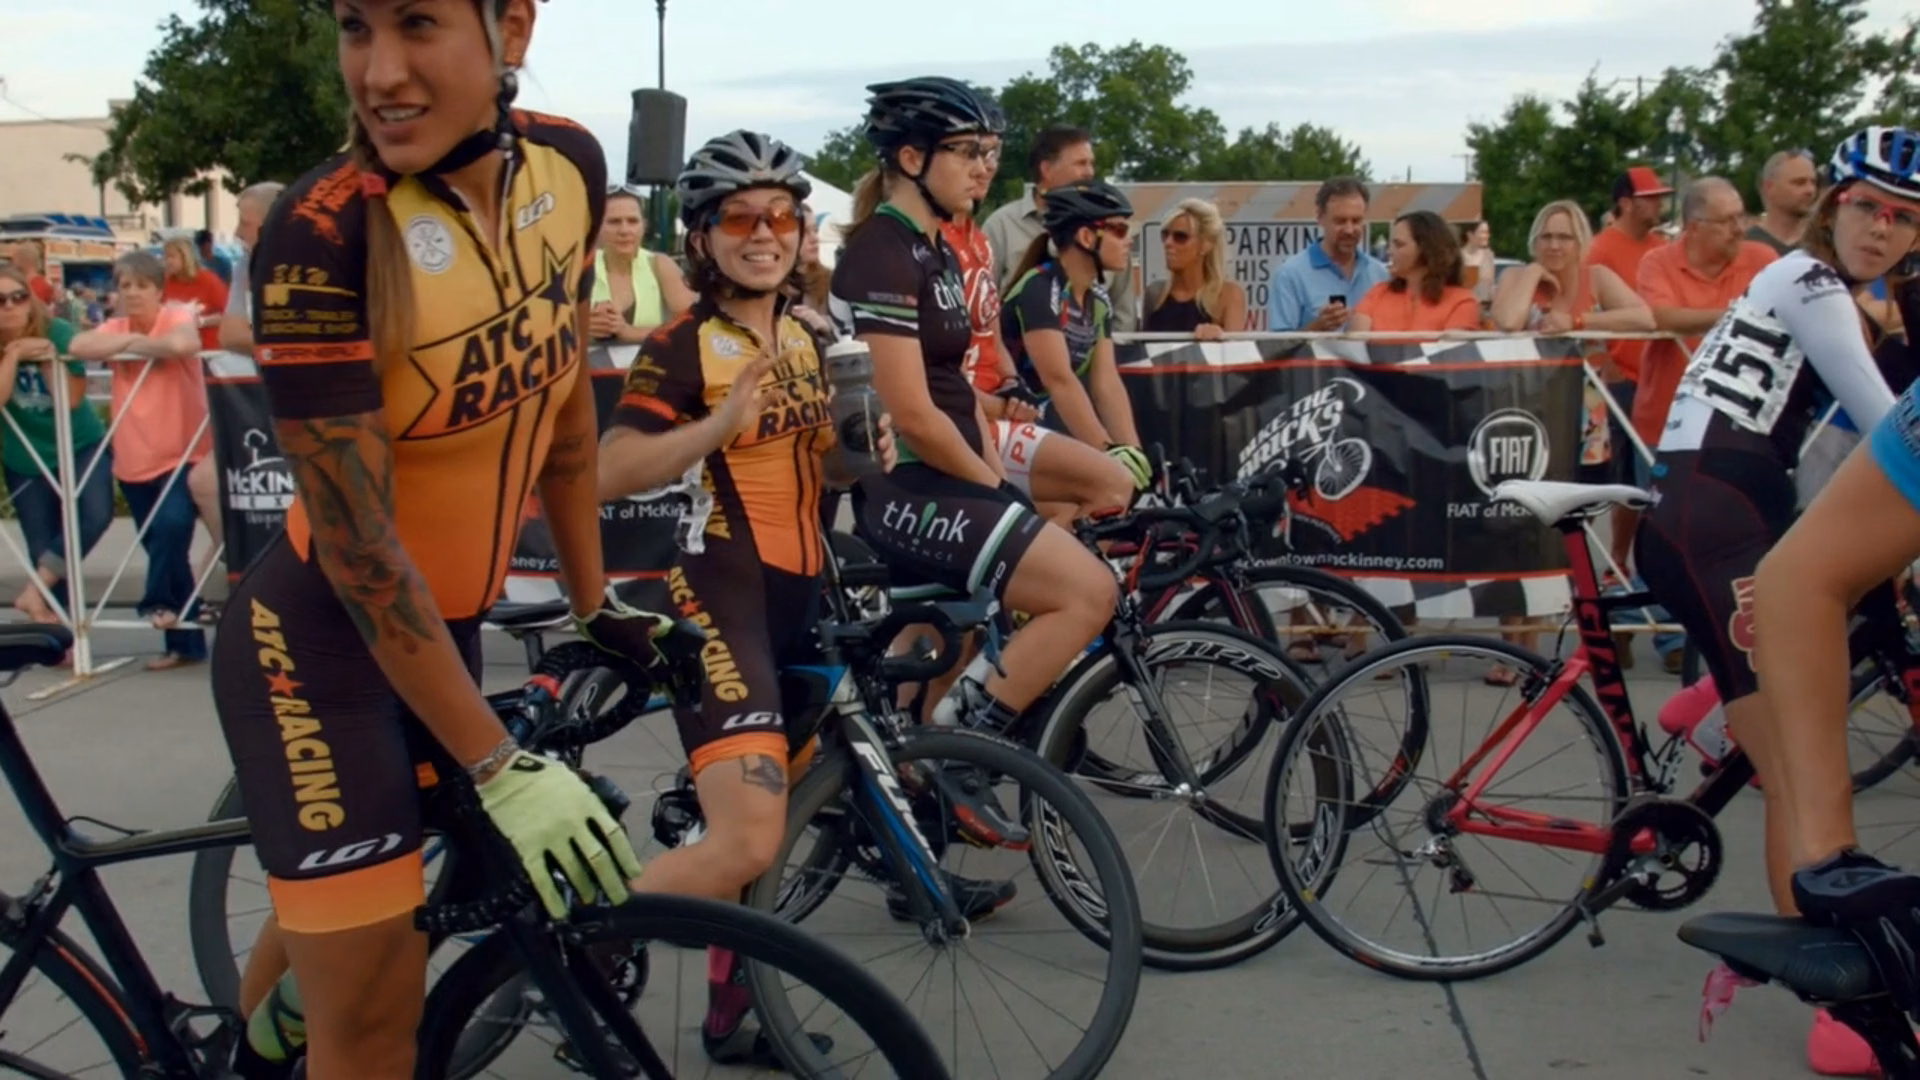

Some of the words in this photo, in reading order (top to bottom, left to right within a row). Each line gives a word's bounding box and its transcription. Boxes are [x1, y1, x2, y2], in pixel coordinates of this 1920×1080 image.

[1226, 259, 1270, 282] HIS
[1246, 284, 1270, 307] 10
[452, 306, 534, 386] ATC
[1703, 318, 1792, 420] 151
[1290, 382, 1338, 417] THE
[1489, 435, 1533, 475] FIAT
[620, 504, 634, 519] of
[1446, 502, 1480, 518] FIAT
[1483, 502, 1500, 518] of
[667, 566, 696, 604] ATC
[251, 597, 296, 673] ATC
[269, 695, 346, 832] RACING
